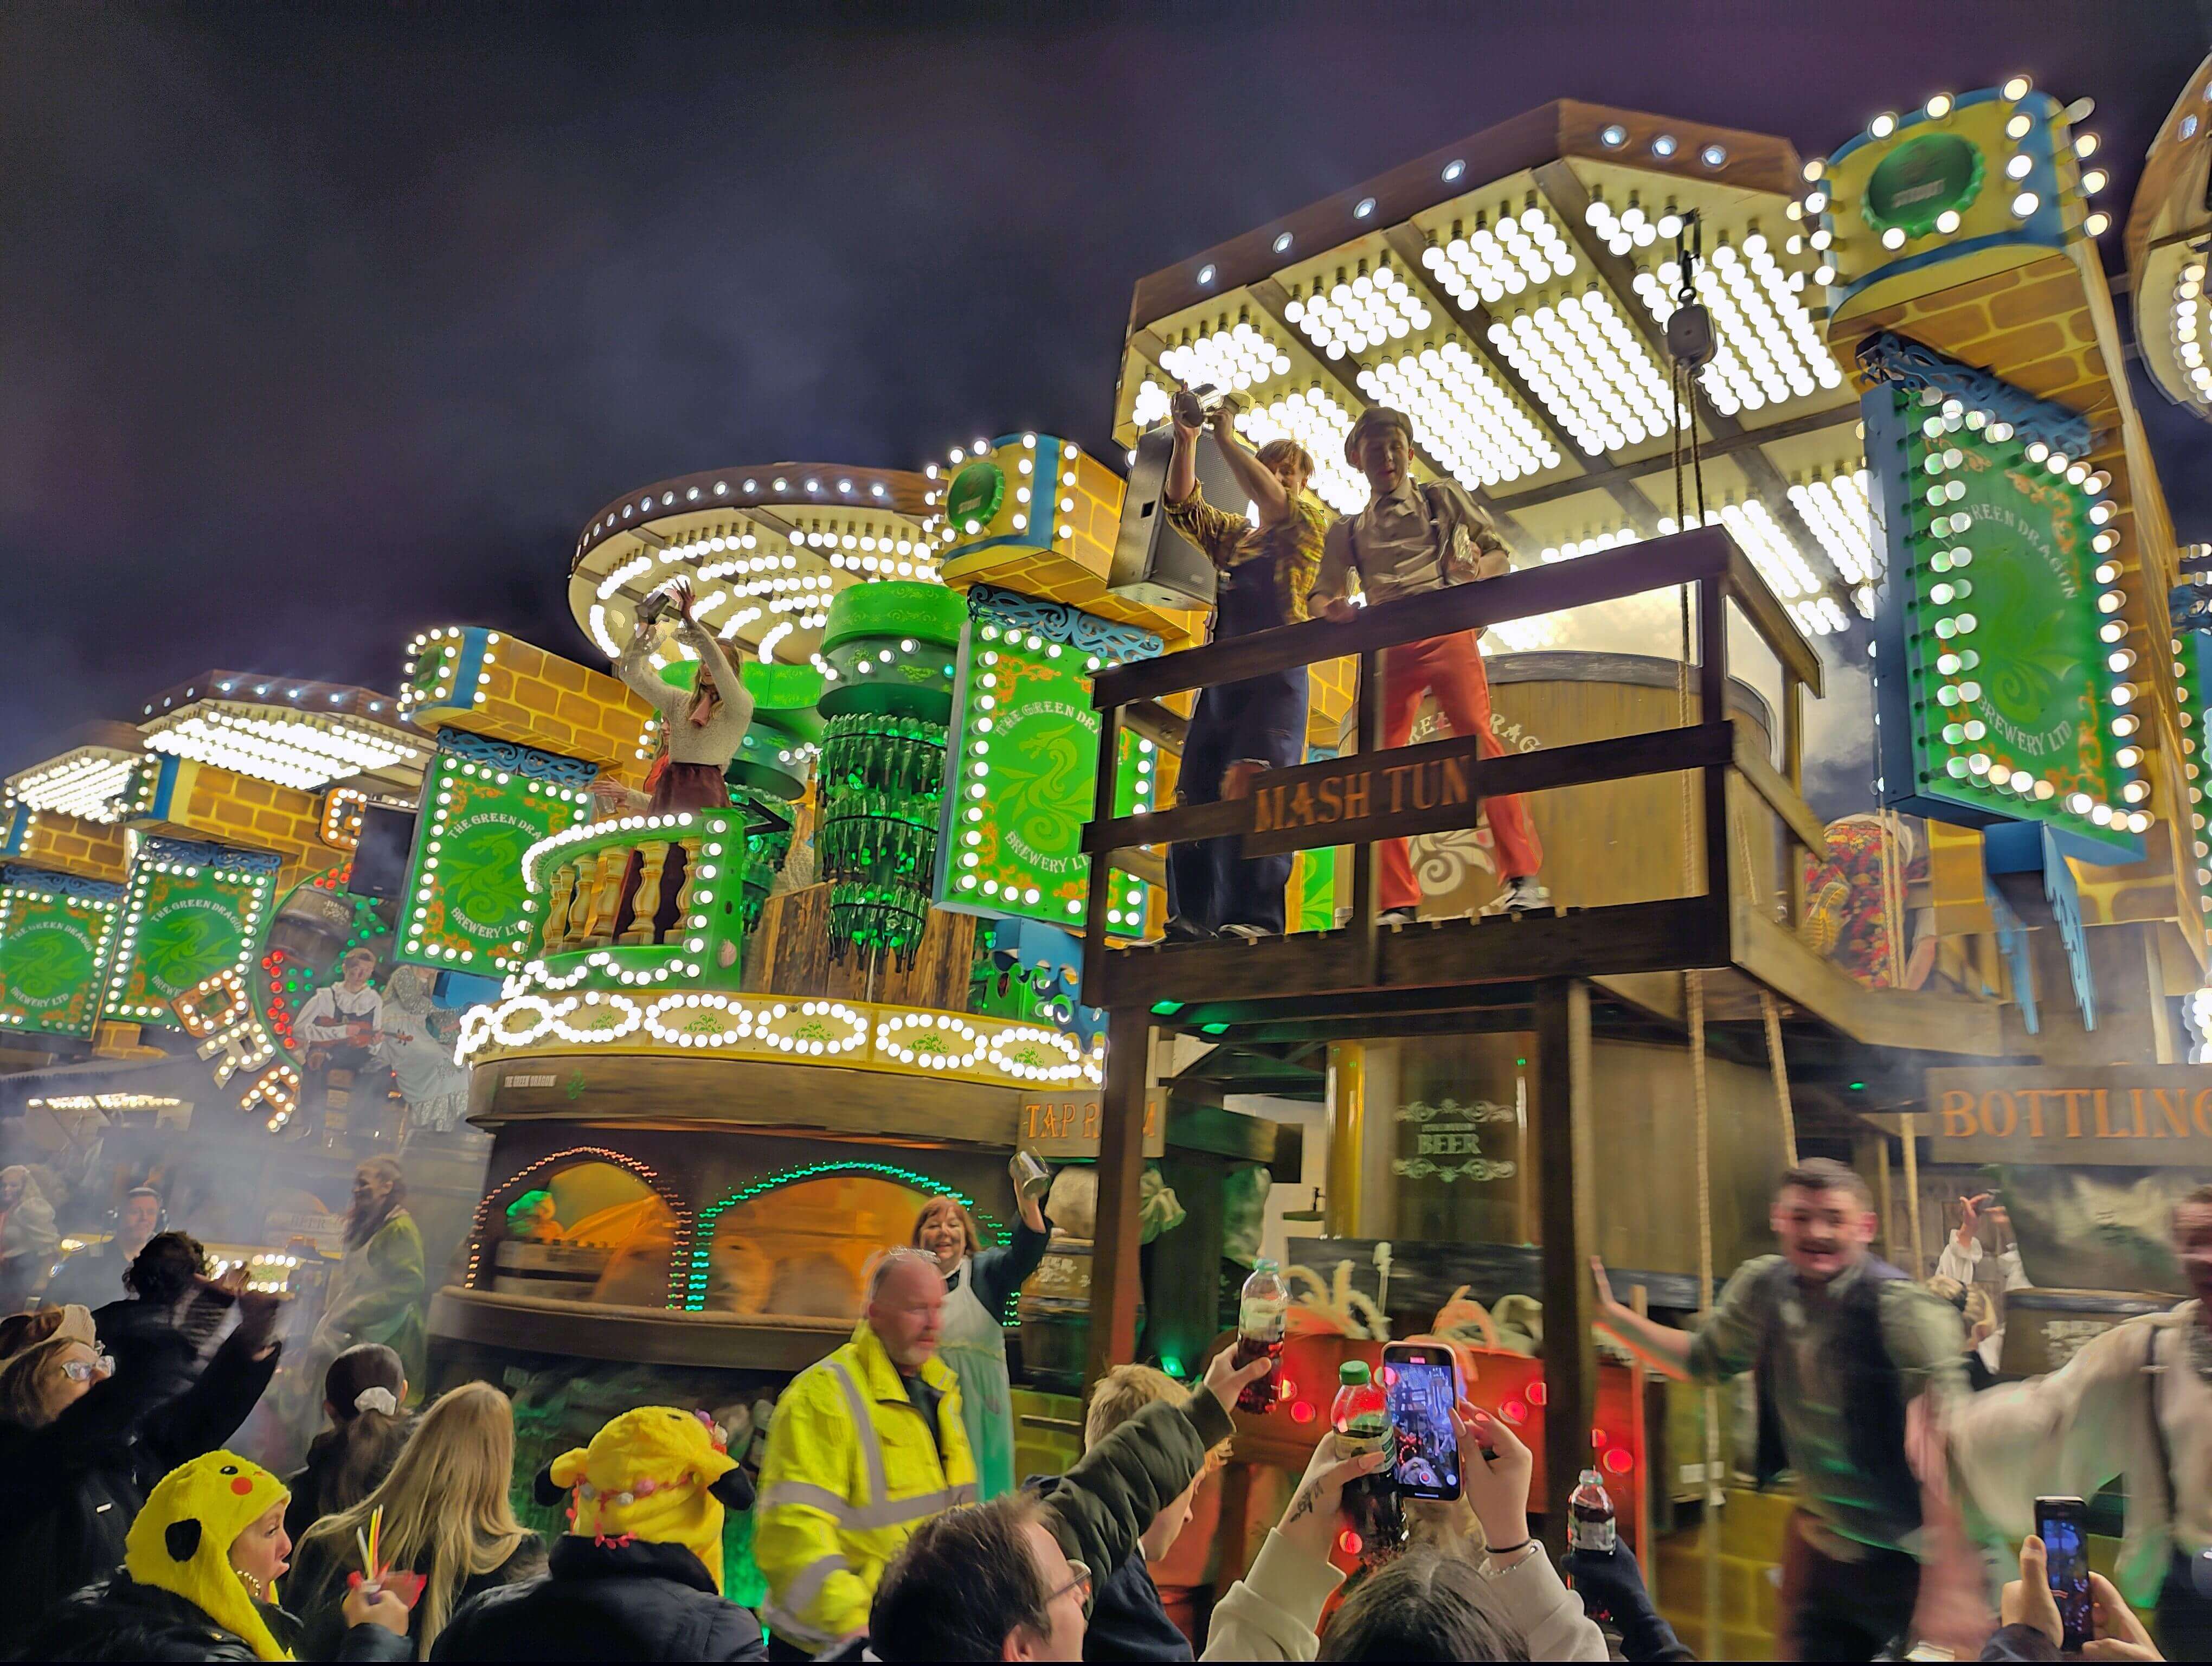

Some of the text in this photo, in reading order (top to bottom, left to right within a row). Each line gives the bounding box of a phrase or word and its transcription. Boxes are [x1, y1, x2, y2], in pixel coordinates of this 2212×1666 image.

[2017, 518, 2078, 599] DRAGON
[993, 709, 1024, 737] THE
[1021, 701, 1075, 717] GREEN
[1978, 694, 2072, 757] BREWERY LTD
[1254, 755, 1470, 834] MASH TUN
[447, 813, 543, 841] THE GREEN DRA
[1005, 830, 1068, 874] BREWERY
[150, 899, 243, 934] THE GREEN DRAGON
[451, 907, 519, 938] BREWERY LT
[10, 986, 69, 1008] BREWERY LTD
[1026, 1103, 1076, 1138] TAP
[1417, 1133, 1482, 1155] BEER
